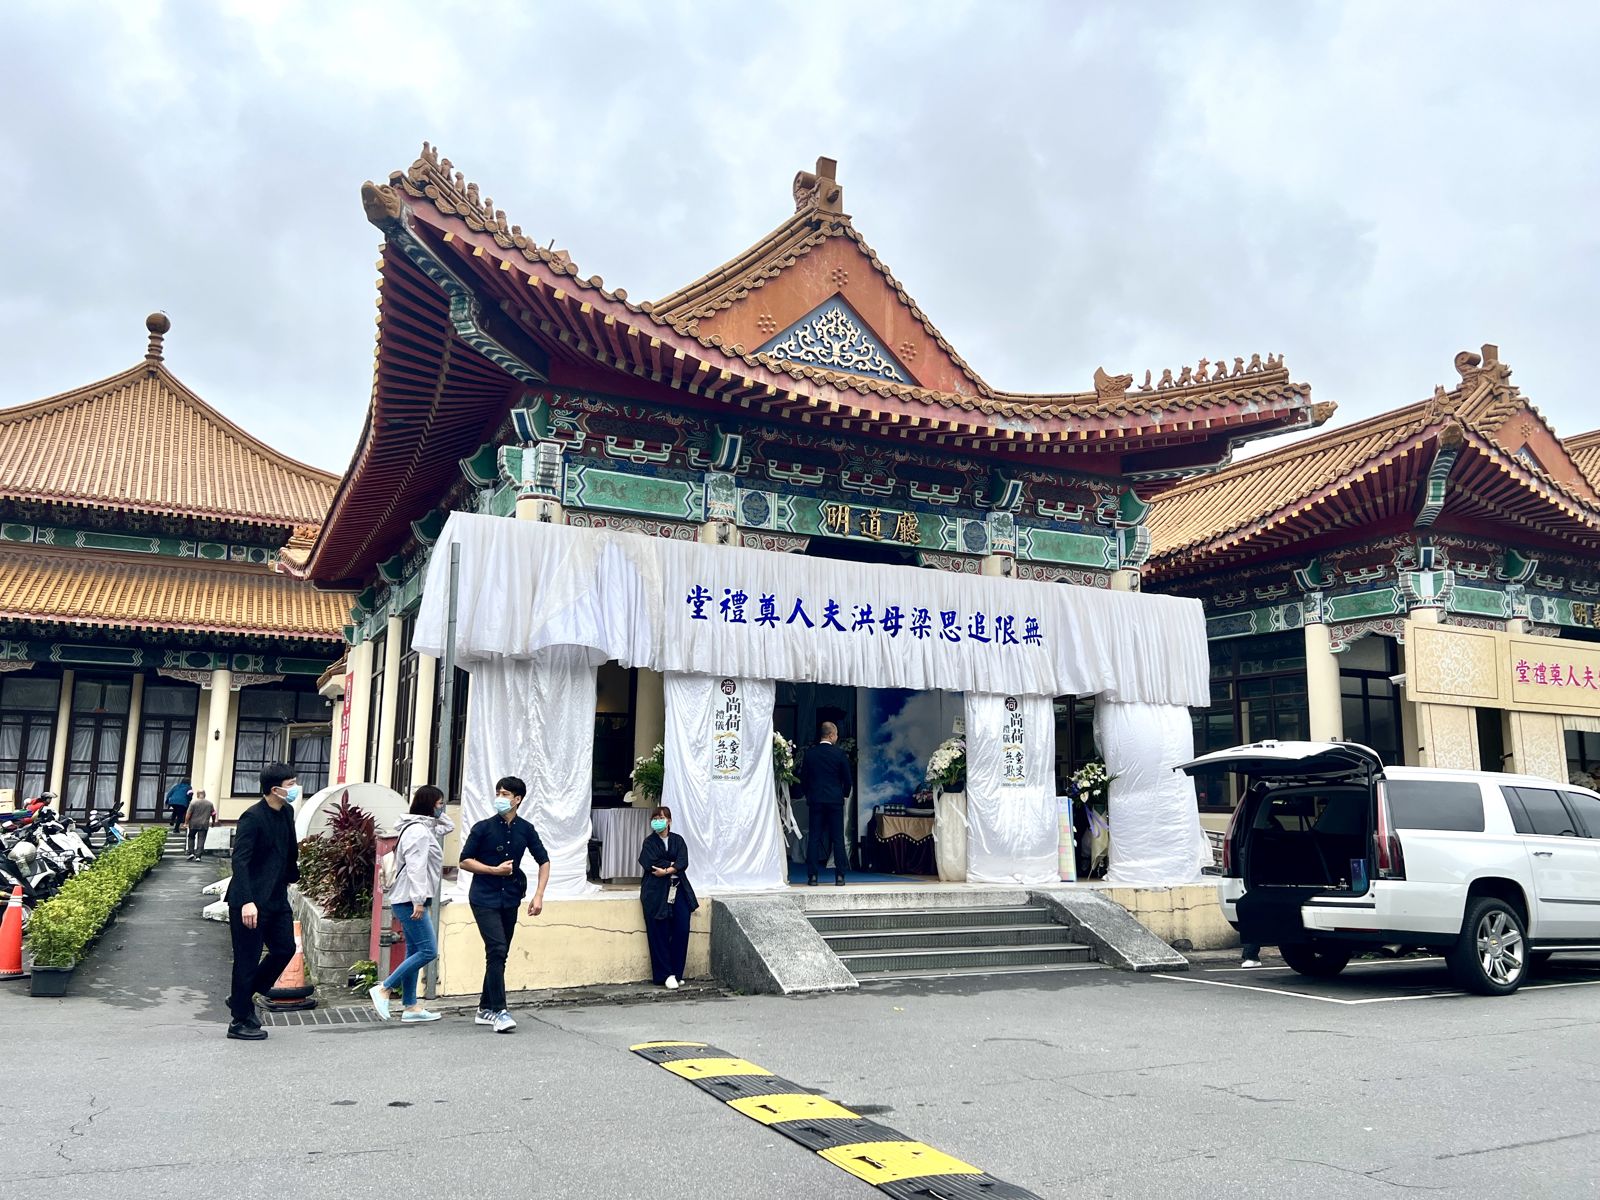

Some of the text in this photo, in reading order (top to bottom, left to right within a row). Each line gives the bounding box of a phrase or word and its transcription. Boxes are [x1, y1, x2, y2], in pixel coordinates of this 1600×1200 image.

[825, 504, 922, 545] 明道廳
[725, 697, 741, 731] 尚荷
[1010, 713, 1024, 744] 尚荷
